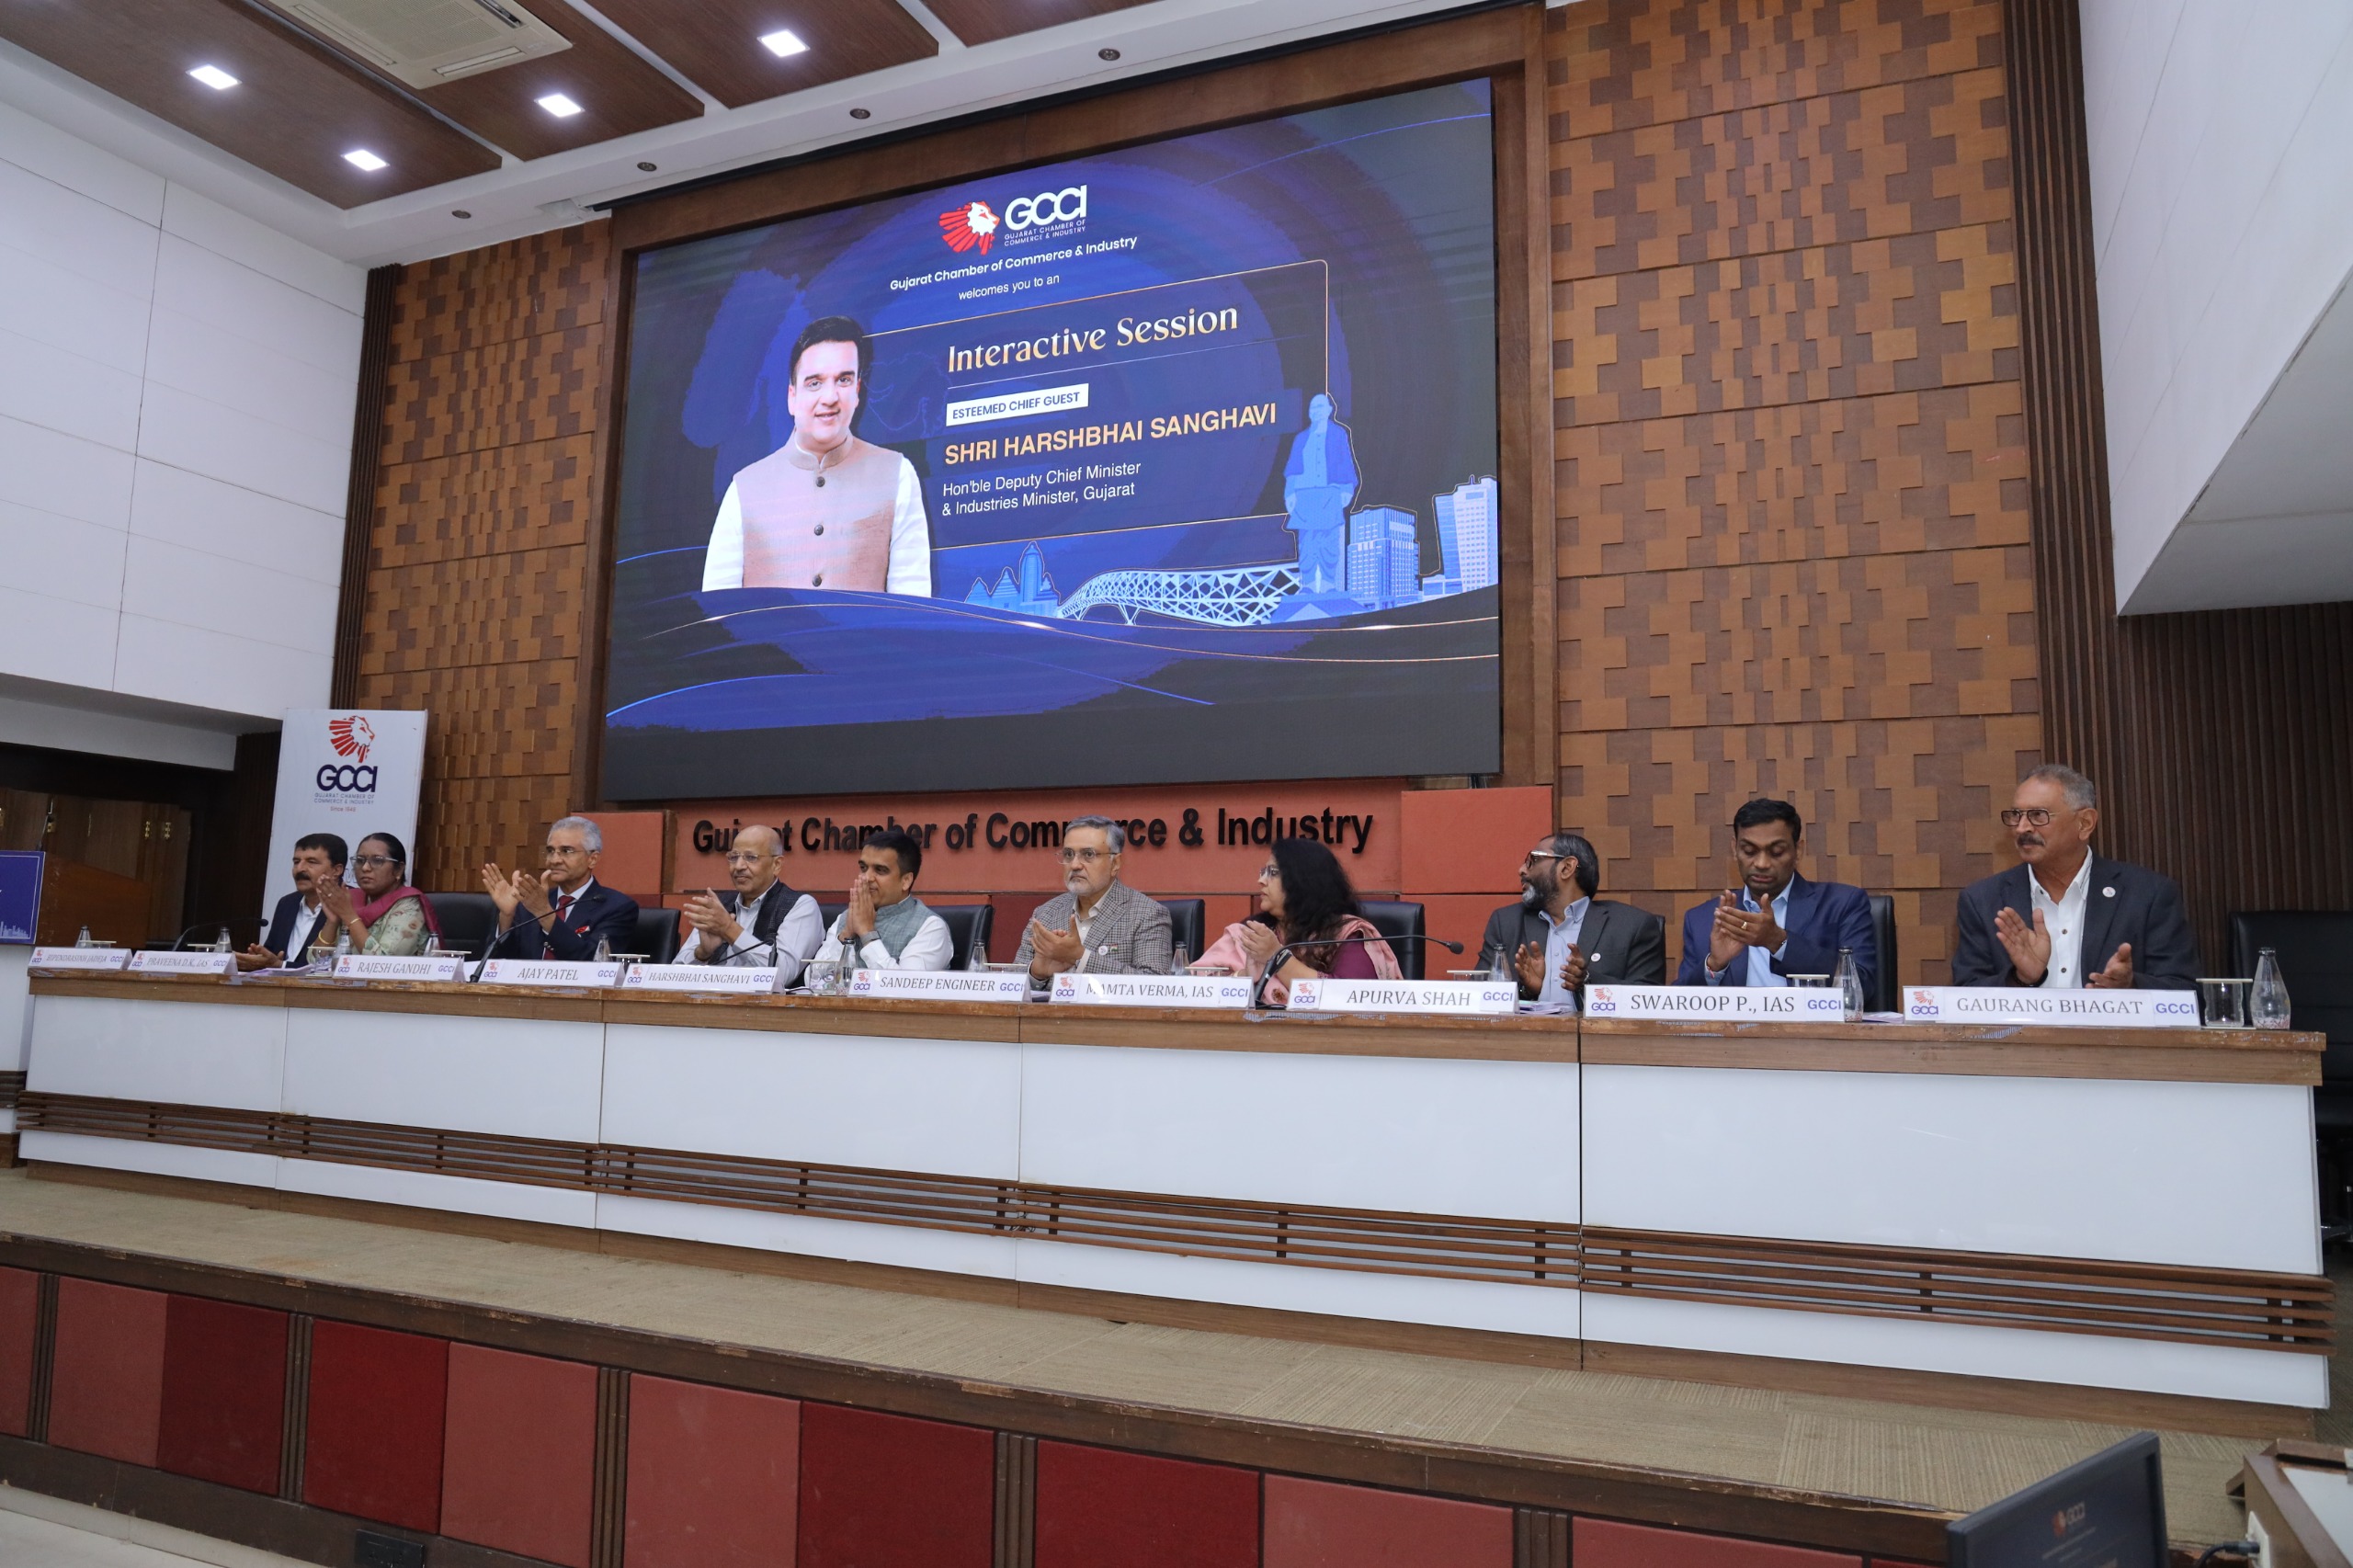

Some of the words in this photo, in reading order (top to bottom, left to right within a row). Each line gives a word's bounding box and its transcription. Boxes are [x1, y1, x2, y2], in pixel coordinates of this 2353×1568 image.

[1005, 185, 1087, 231] GCCI
[1004, 228, 1037, 240] GUJARAT
[1039, 222, 1074, 233] CHAMBER
[1075, 219, 1086, 227] OF
[1004, 233, 1043, 246] COMMERCE
[1051, 226, 1086, 238] INDUSTRY
[890, 273, 932, 291] Gujarat
[934, 263, 990, 283] Chamber
[991, 259, 1004, 272] of
[1005, 247, 1073, 270] Commerce
[1074, 245, 1084, 256] &
[1086, 236, 1138, 256] Industry
[958, 282, 1009, 301] welcomes
[1012, 278, 1031, 294] you
[1033, 277, 1044, 288] to
[1046, 275, 1060, 287] an
[948, 327, 1107, 373] Interactive
[1116, 306, 1239, 347] Session
[952, 402, 1006, 419] ESTEEMED
[1008, 396, 1041, 412] CHIEF
[1043, 392, 1081, 407] GUEST
[945, 438, 997, 465] SHRI
[1004, 420, 1143, 458] HARSHBHAI
[1150, 402, 1278, 439] SANGHAVI
[943, 478, 991, 497] Hon'ble
[995, 471, 1042, 494] Deputy
[1046, 466, 1083, 485] Chief
[1086, 461, 1142, 480] Minister
[942, 502, 951, 517] &
[955, 494, 1018, 515] Industries
[1022, 486, 1079, 508] Minister,
[1083, 482, 1135, 504] Gujarat
[316, 764, 379, 792] GCCI
[945, 812, 978, 850] of
[1178, 808, 1205, 846] &
[1218, 806, 1374, 855] Industry
[147, 958, 181, 966] PRAVEENA
[357, 962, 392, 974] RAJESH
[392, 964, 432, 974] GANDHI
[517, 968, 545, 980] AJAY
[545, 968, 579, 981] PATEL
[597, 970, 617, 978] GCCI
[648, 972, 702, 983] HARSHBHAI
[702, 973, 751, 984] SANGHAVI
[753, 974, 775, 983] GCCI
[853, 983, 870, 991] GCCI
[880, 976, 933, 989] SANDEEP
[935, 978, 995, 992] ENGINEER
[999, 983, 1024, 992] GCCI
[1139, 984, 1188, 998] VERMA,
[1191, 986, 1214, 998] IAS
[1055, 988, 1075, 997] GCCI
[1221, 987, 1248, 997] GCCI
[1347, 990, 1417, 1006] APURVA
[1422, 991, 1472, 1006] SHAH
[1483, 991, 1513, 1002] GCCI
[1294, 995, 1316, 1004] GCCI
[1591, 1002, 1616, 1011] GCCI
[1631, 994, 1730, 1012] SWAROOP
[1763, 995, 1795, 1013] IAS
[1807, 999, 1842, 1011] GCCI
[1956, 996, 2053, 1013] GAURANG
[2059, 999, 2143, 1015] BHAGAT
[1911, 1006, 1939, 1015] GCCI
[2155, 1002, 2196, 1015] GCCI
